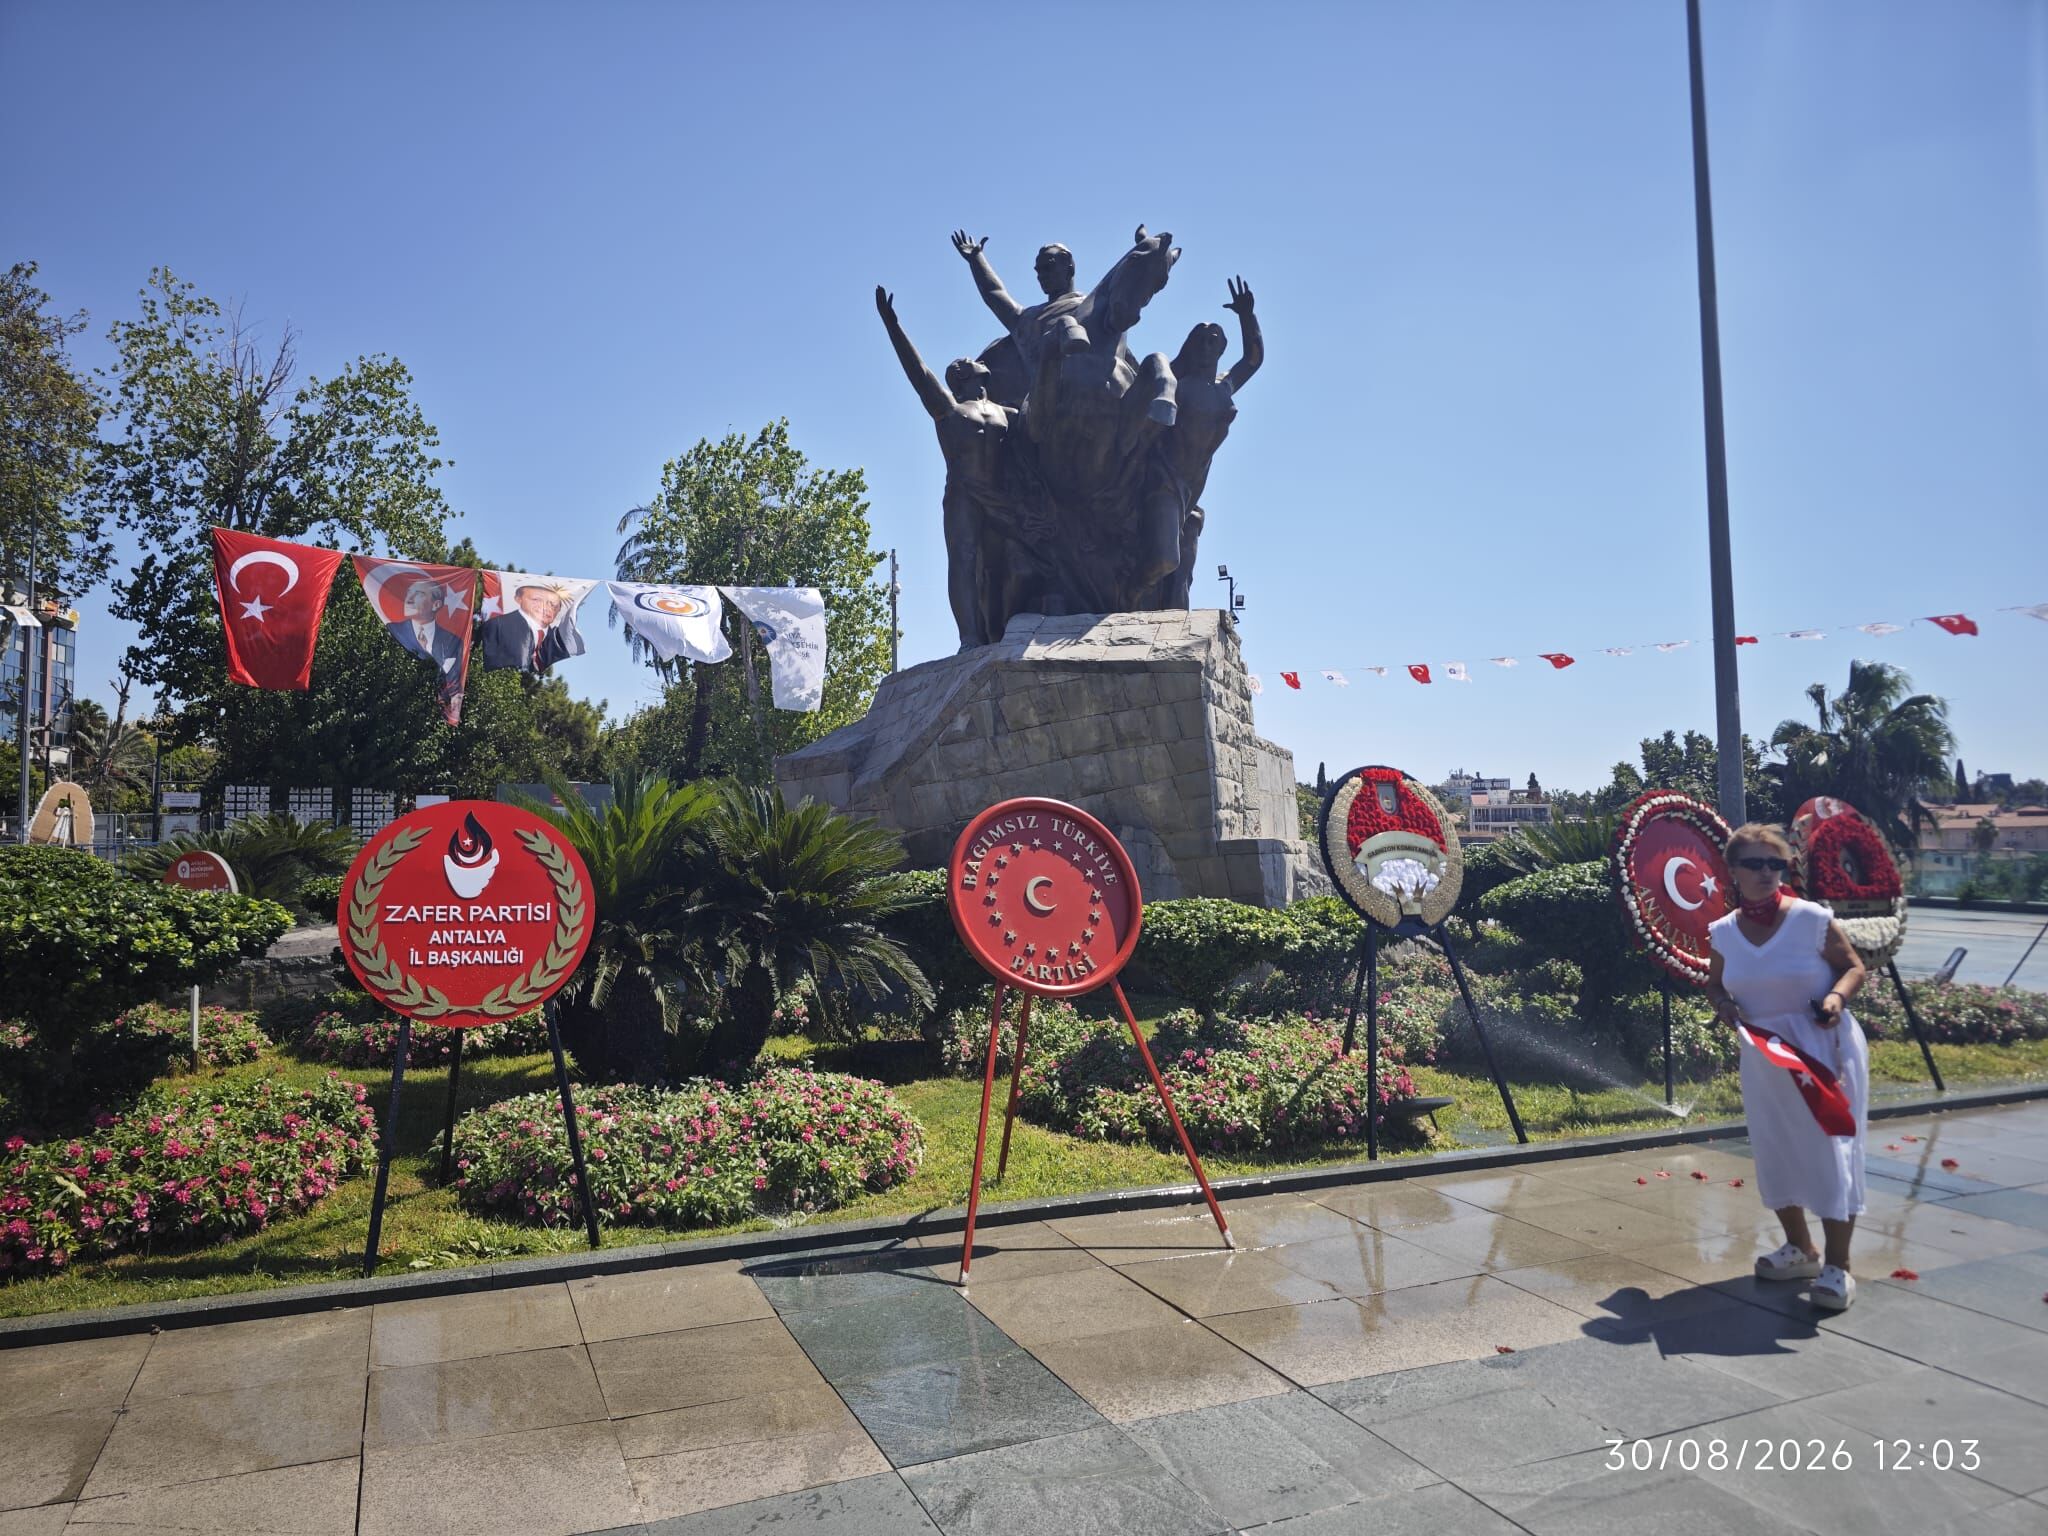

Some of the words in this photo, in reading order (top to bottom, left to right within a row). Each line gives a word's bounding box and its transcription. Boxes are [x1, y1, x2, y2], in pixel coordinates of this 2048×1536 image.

[963, 815, 1039, 889] BAĞIMSIZ
[1051, 818, 1118, 886] TÜRKİYE
[385, 905, 464, 922] ZAFER
[470, 902, 551, 921] PARTİSİ
[429, 930, 506, 944] ANTALYA
[410, 948, 424, 965] İL
[428, 947, 523, 967] BAŞKANLIĞI
[1011, 951, 1098, 981] PARTİSİ
